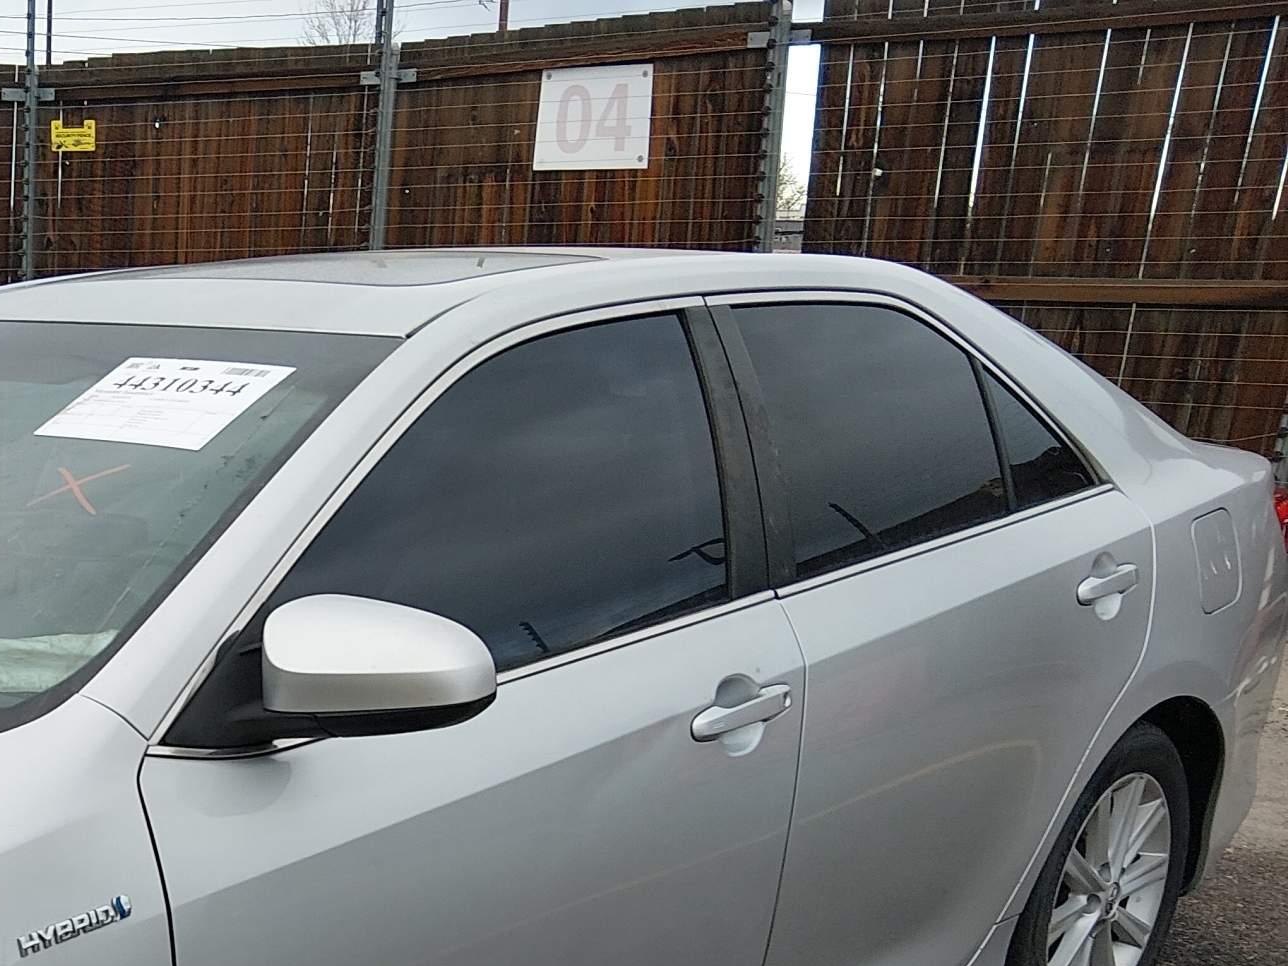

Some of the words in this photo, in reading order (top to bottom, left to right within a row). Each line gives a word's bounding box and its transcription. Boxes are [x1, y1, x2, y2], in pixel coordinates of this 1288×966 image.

[555, 82, 632, 155] 04
[113, 374, 250, 397] 44310344
[17, 904, 121, 959] HYBRID
